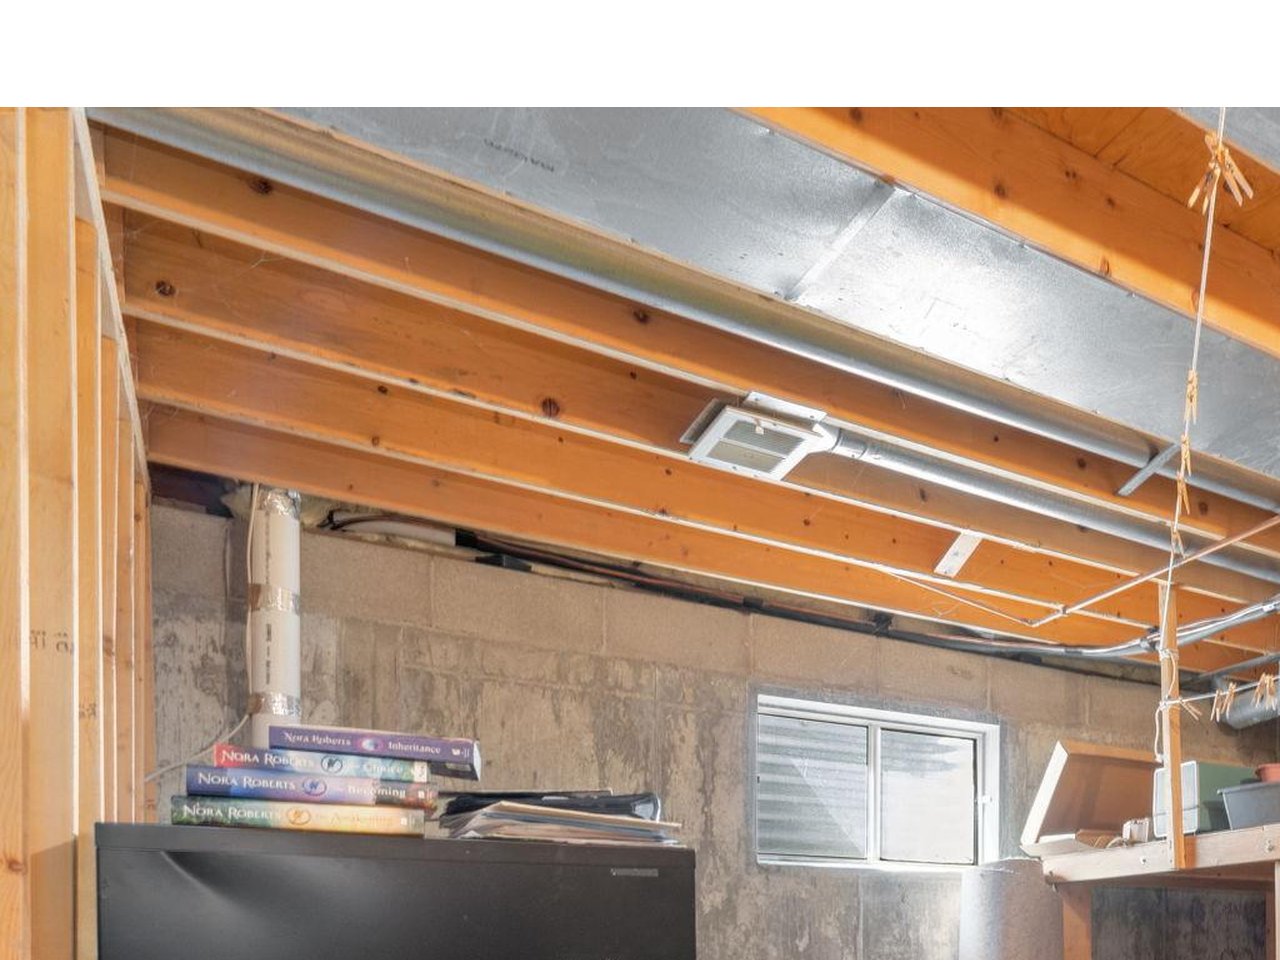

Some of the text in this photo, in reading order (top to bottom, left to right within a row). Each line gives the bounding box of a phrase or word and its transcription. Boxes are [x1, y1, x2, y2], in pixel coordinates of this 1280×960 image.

[283, 731, 441, 755] Nora Roberts Inheritance
[221, 750, 316, 768] NORA ROBERTS
[198, 771, 296, 791] NORA ROBERTS
[347, 785, 406, 799] Becoming
[182, 803, 223, 818] NORA
